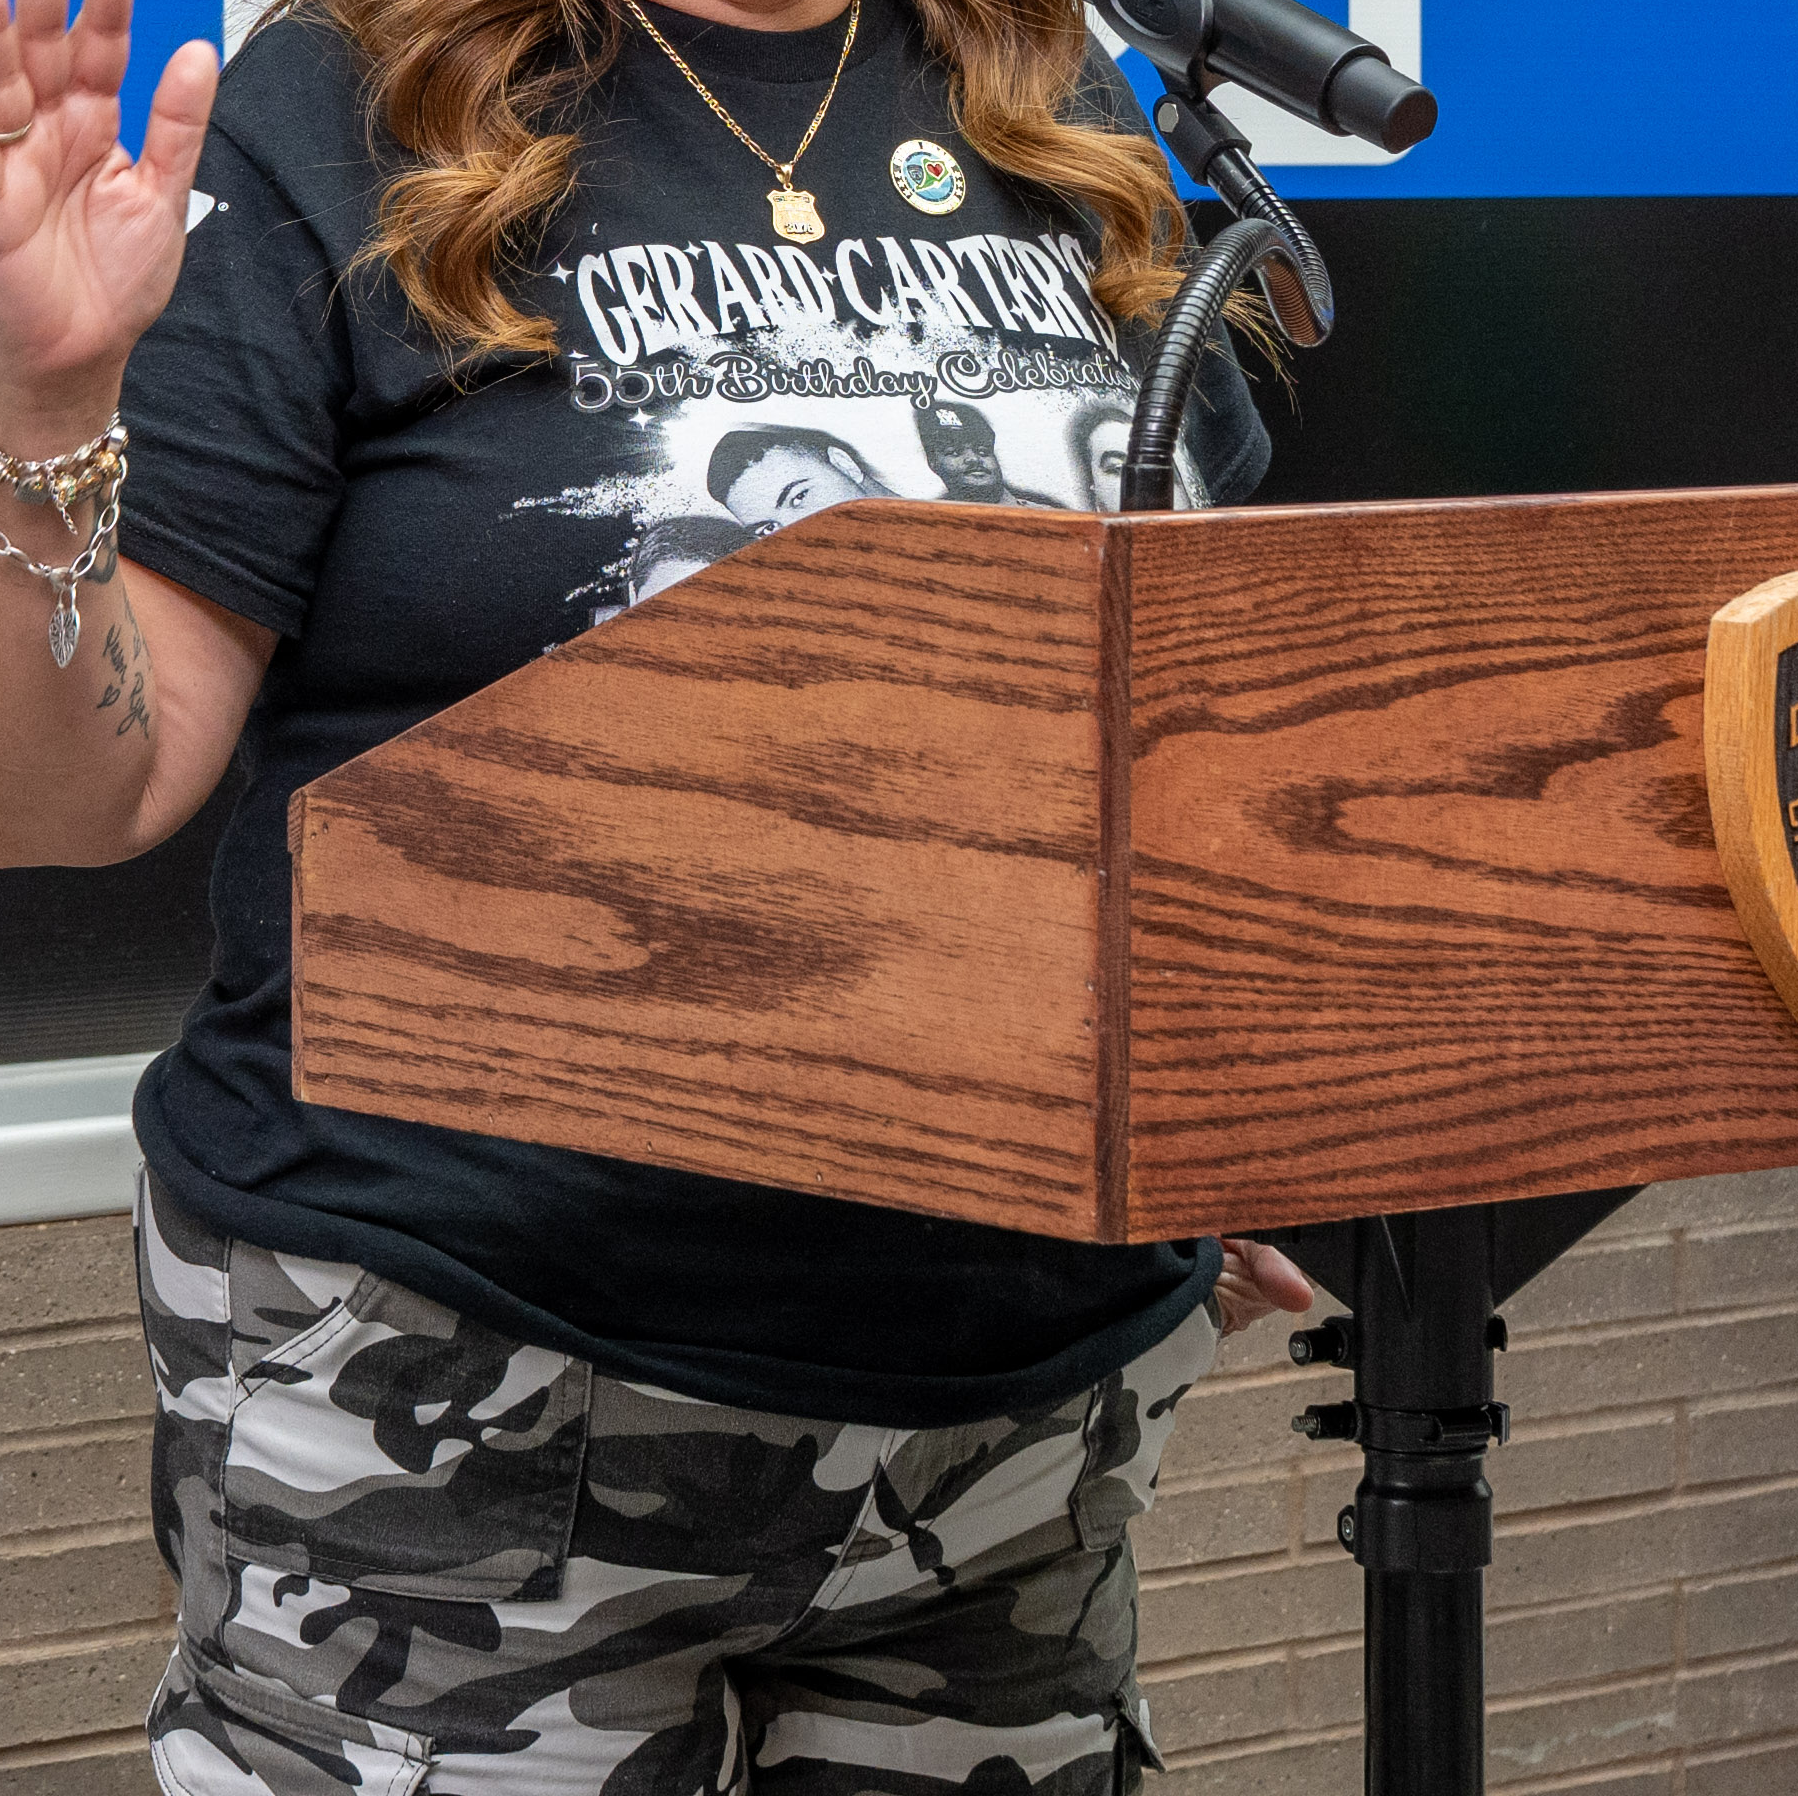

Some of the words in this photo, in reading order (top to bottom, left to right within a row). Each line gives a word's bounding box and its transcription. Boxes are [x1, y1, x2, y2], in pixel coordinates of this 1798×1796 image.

[576, 240, 837, 365] GERARD
[573, 359, 709, 411] 55th
[711, 351, 937, 409] Birthday
